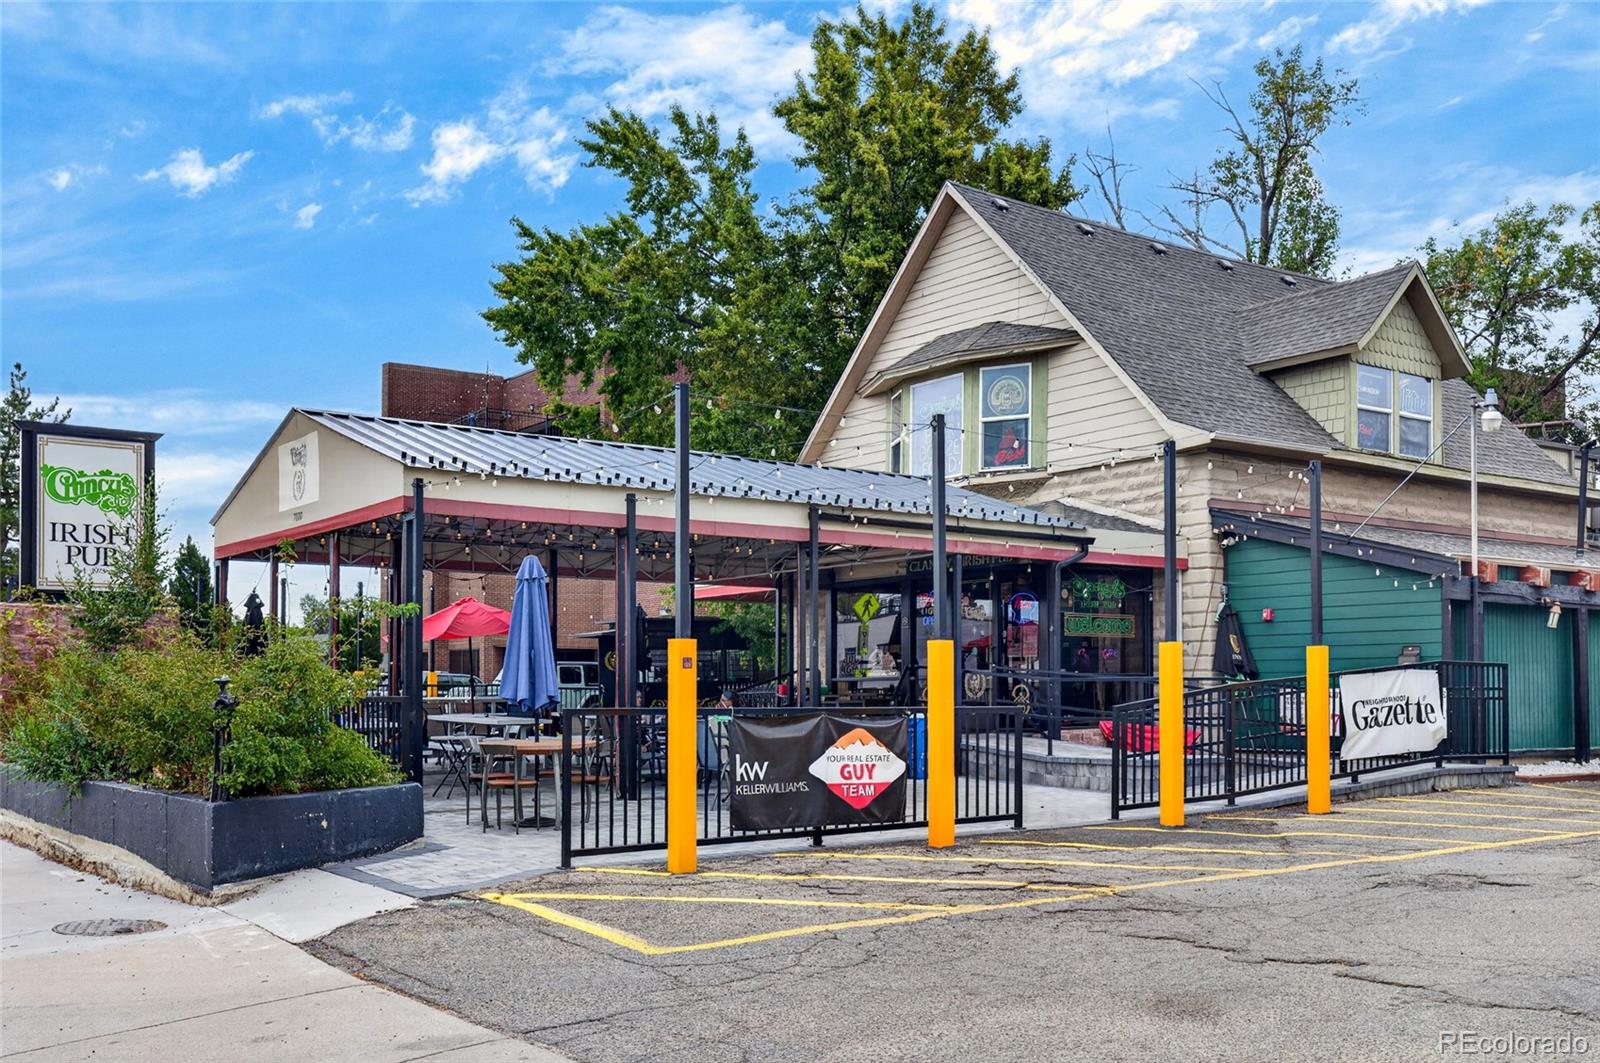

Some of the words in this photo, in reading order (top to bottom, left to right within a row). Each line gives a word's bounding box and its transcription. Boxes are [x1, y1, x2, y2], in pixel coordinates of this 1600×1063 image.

[49, 521, 132, 545] IRISH
[1352, 696, 1437, 731] Gazette
[826, 755, 846, 763] YOUR
[847, 754, 863, 763] REAL
[865, 754, 891, 762] ESTATE
[840, 763, 876, 780] GUY
[841, 784, 875, 797] TEAM
